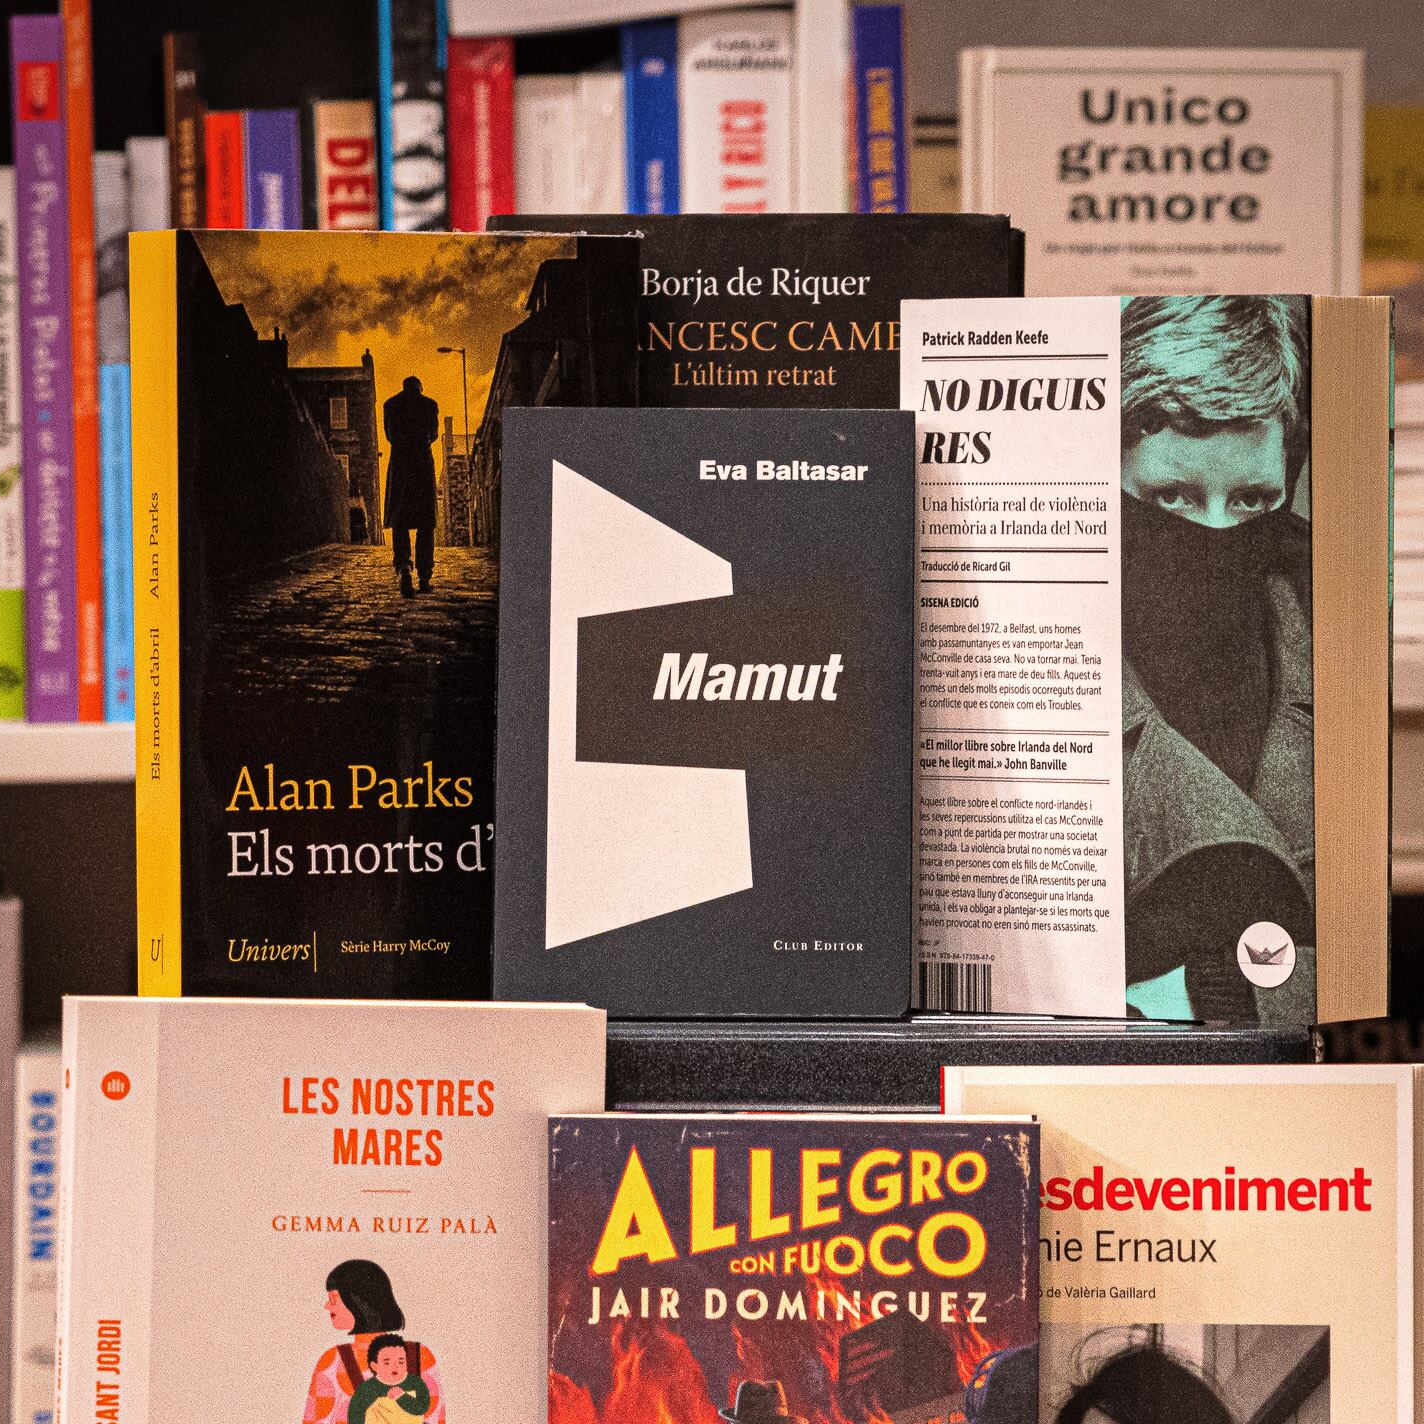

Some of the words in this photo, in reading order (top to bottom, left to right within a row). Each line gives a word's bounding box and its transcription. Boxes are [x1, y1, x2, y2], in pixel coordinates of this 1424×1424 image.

[1081, 87, 1251, 127] Unico
[1057, 134, 1271, 184] grande
[1066, 184, 1262, 226] amore
[643, 269, 718, 304] Borja
[727, 266, 762, 296] de
[772, 268, 870, 304] Riquer
[639, 320, 776, 350] NCESC
[923, 332, 964, 345] Patrick
[968, 331, 1012, 345] Radden
[1016, 331, 1048, 344] Keefe
[675, 362, 757, 385] L'últim
[767, 366, 836, 386] retrat
[920, 379, 971, 412] NO
[975, 377, 1107, 412] DIGUIS
[920, 431, 992, 465] RES
[700, 461, 746, 480] Eva
[757, 461, 868, 480] Baltasar
[149, 492, 158, 546] Parks
[921, 498, 948, 512] Una
[950, 496, 1000, 512] història
[1002, 496, 1026, 512] real
[1029, 496, 1045, 512] de
[1048, 496, 1107, 512] violència
[921, 520, 925, 535] i
[928, 520, 986, 535] memòria
[989, 524, 997, 535] a
[1001, 520, 1047, 535] Irlanda
[1050, 520, 1071, 535] del
[1074, 520, 1107, 535] Nord
[149, 553, 159, 598] Alan
[920, 560, 959, 573] Traducció
[961, 561, 971, 573] de
[972, 561, 996, 573] Ricard
[998, 561, 1011, 573] Gil
[920, 597, 949, 608] SISENA
[950, 595, 979, 608] EDICIÓ
[150, 628, 160, 687] d'abril
[654, 654, 843, 700] Mamut
[152, 691, 160, 747] morts
[151, 753, 160, 780] Els
[226, 763, 334, 811] Alan
[348, 761, 473, 809] Parks
[227, 828, 294, 876] Els
[307, 836, 443, 874] morts
[228, 939, 311, 962] Univers
[341, 941, 370, 953] Sèrie
[373, 940, 406, 955] Harry
[410, 939, 450, 953] McCoy
[773, 940, 808, 950] CLUB
[814, 940, 863, 951] EDITOR
[283, 1077, 339, 1114] LES
[353, 1079, 494, 1117] NOSTRES
[334, 1129, 442, 1166] MARES
[29, 1091, 57, 1263] BOURDAIN
[272, 1216, 360, 1232] GEMMA
[373, 1217, 428, 1233] RUIZ
[441, 1215, 497, 1234] PALÀ
[588, 1142, 989, 1277] ALLEGRO
[729, 1257, 775, 1276] CON
[783, 1210, 988, 1278] FUOCO
[1096, 1230, 1218, 1264] Ernaux
[588, 1287, 681, 1326] JAIR
[703, 1286, 988, 1324] DOMINGUEZ
[1046, 1286, 1062, 1298] de
[1065, 1286, 1107, 1299] Valèria
[1109, 1286, 1157, 1299] Gaillard
[97, 1320, 121, 1374] JORDI
